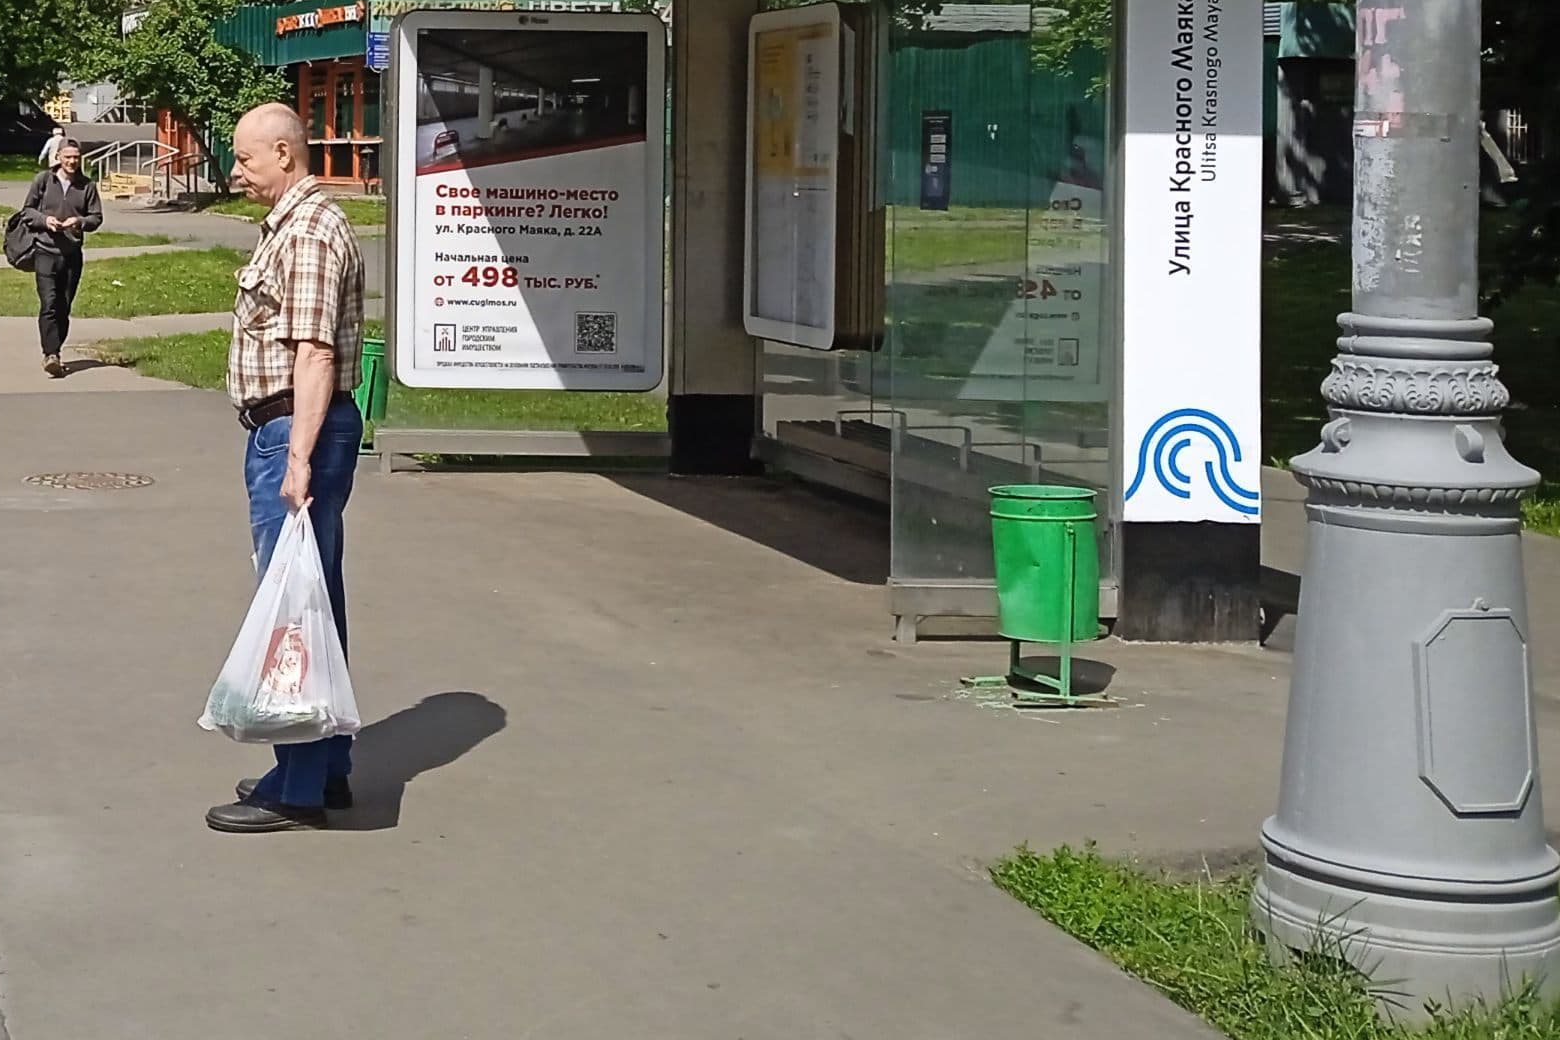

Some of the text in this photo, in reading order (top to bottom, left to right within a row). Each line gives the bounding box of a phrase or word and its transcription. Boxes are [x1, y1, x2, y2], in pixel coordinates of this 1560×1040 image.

[1202, 46, 1221, 127] Krasnogo
[1169, 77, 1196, 192] Красного
[1201, 133, 1217, 181] Ulitsa
[436, 185, 619, 201] Свое машино-место
[436, 204, 608, 219] в паркинге? Легко!
[435, 224, 602, 237] ул. Красного Маяка, д. 22А
[1169, 200, 1193, 275] Улица
[435, 252, 529, 264] Начальная цена
[462, 266, 519, 288] 498
[524, 277, 561, 289] ТЫС.
[462, 325, 480, 333] ЦЕНТР
